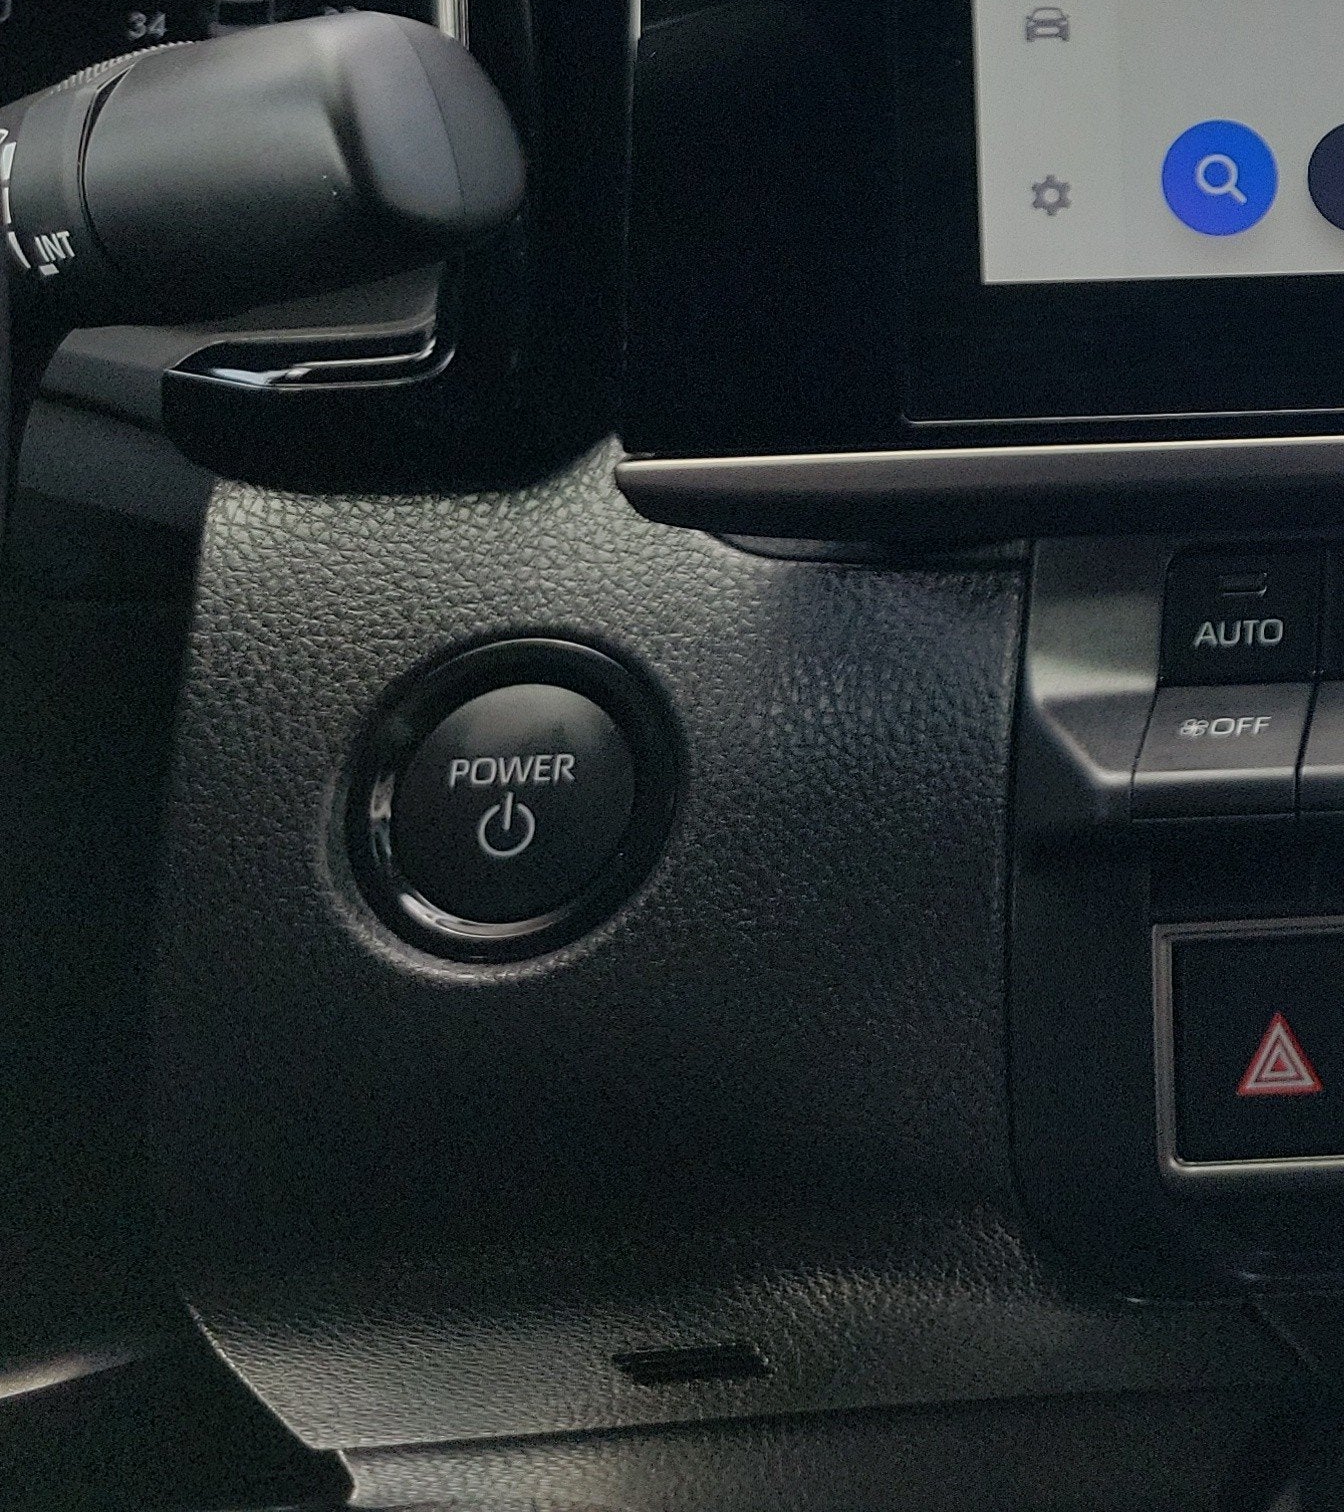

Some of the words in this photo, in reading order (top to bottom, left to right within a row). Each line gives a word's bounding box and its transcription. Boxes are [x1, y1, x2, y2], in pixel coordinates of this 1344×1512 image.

[128, 10, 167, 40] 34
[34, 230, 76, 263] INT
[1194, 618, 1284, 648] AUTO
[1209, 715, 1273, 737] OFF
[449, 753, 577, 790] POWER
